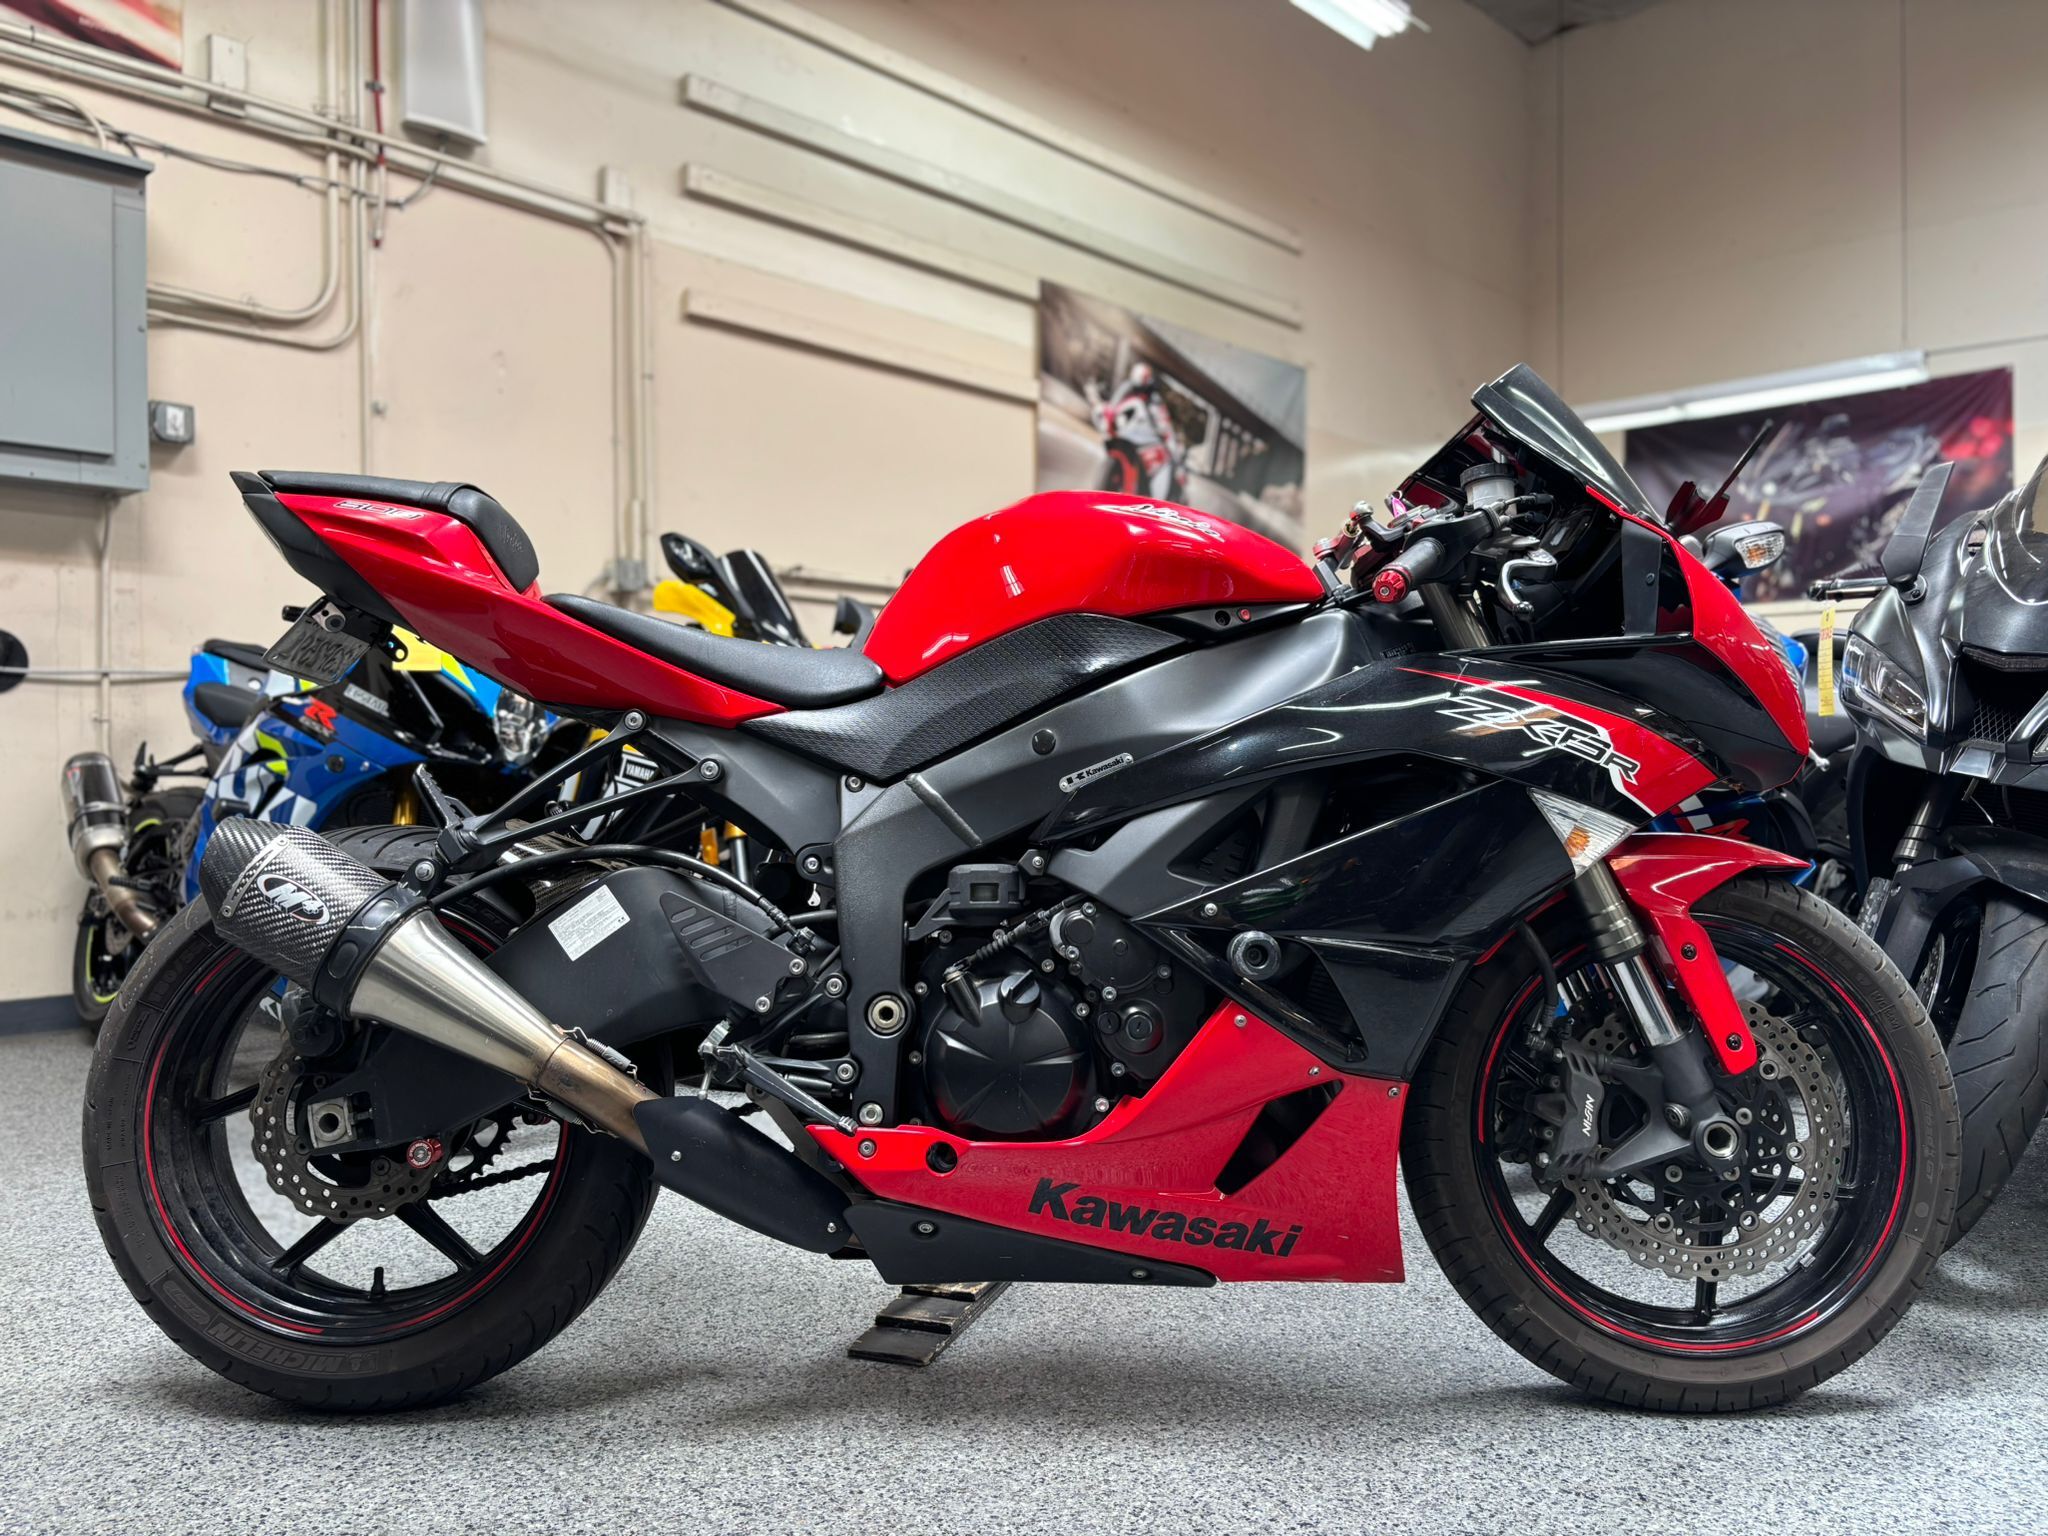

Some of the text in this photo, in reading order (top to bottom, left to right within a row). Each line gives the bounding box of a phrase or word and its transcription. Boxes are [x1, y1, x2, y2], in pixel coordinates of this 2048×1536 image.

[1085, 757, 1125, 777] Kawasaki
[1027, 1176, 1304, 1258] Kawasaki
[207, 1321, 344, 1373] MICHELIN
